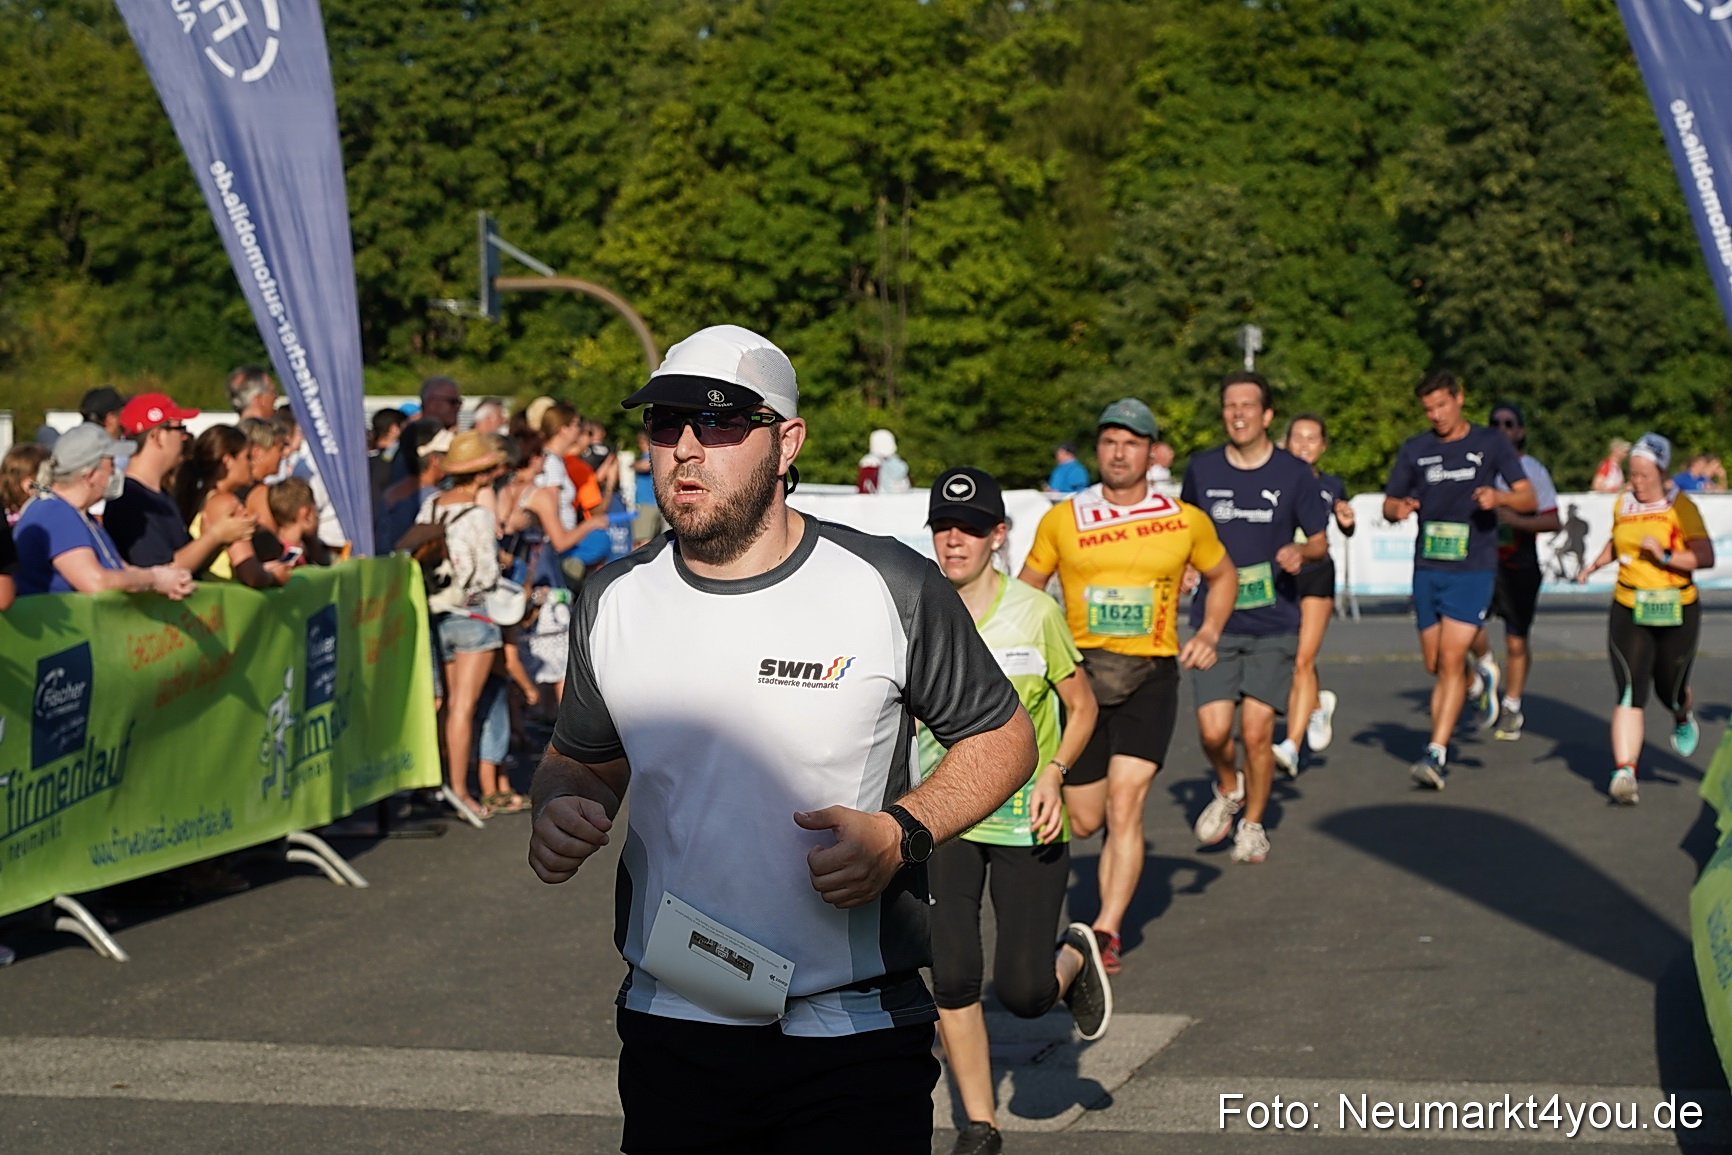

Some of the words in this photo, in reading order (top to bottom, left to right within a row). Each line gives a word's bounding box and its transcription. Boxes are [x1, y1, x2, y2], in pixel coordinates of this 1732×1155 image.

[1079, 530, 1129, 549] MAX
[1136, 519, 1188, 538] BÖGL
[1100, 604, 1144, 620] 1623
[758, 658, 824, 680] swn
[757, 677, 801, 688] stadtwerke
[801, 681, 839, 690] neumarkt
